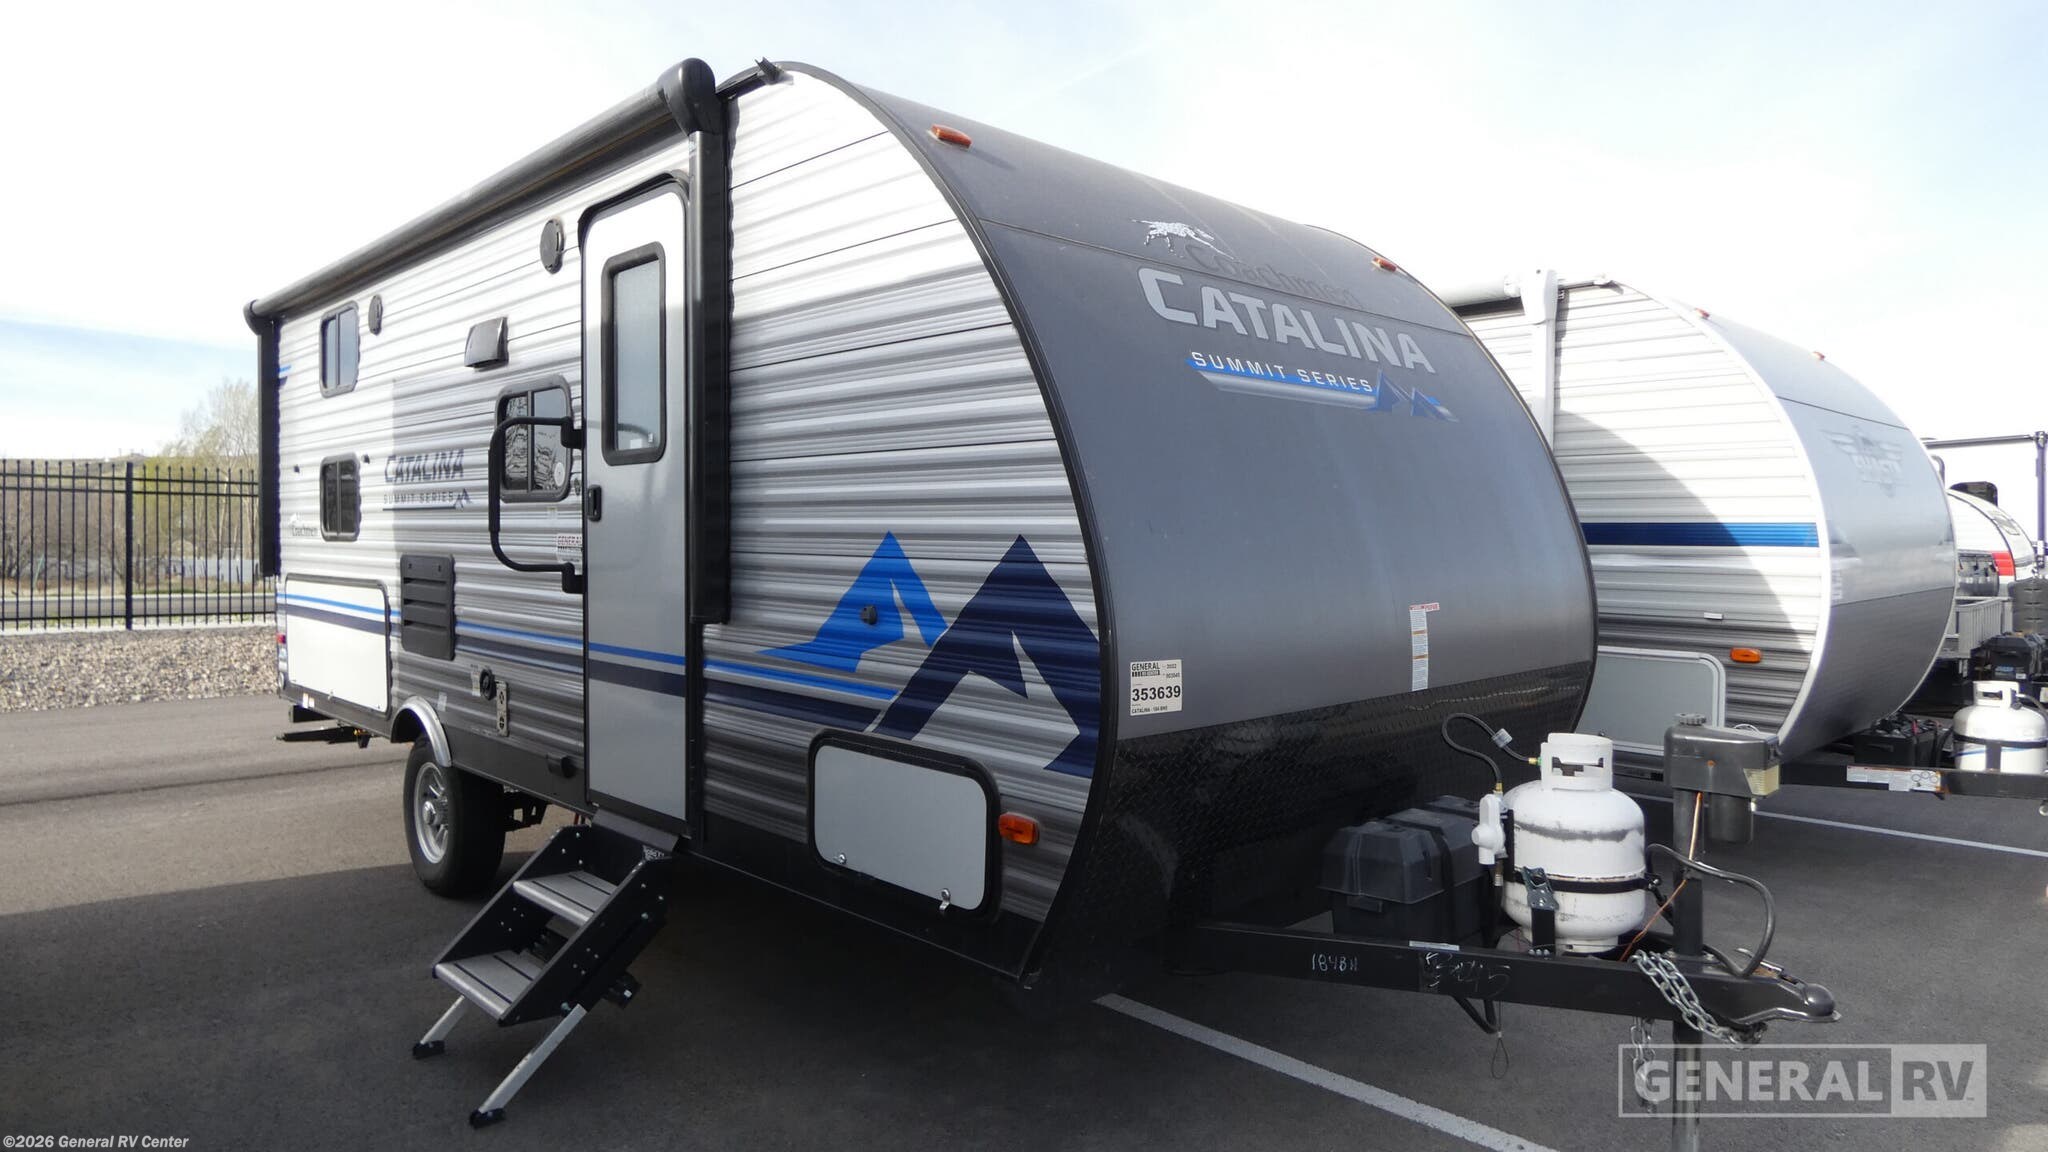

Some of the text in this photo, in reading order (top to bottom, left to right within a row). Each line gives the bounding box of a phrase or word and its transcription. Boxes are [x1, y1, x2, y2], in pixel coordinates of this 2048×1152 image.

[1138, 267, 1435, 374] CATALINA
[1191, 351, 1373, 392] SUMMIT SERIES
[384, 448, 464, 483] CATALINA
[384, 490, 454, 504] SUMMIT SERIES
[1131, 662, 1161, 671] GENERAL
[1132, 685, 1181, 701] 353639
